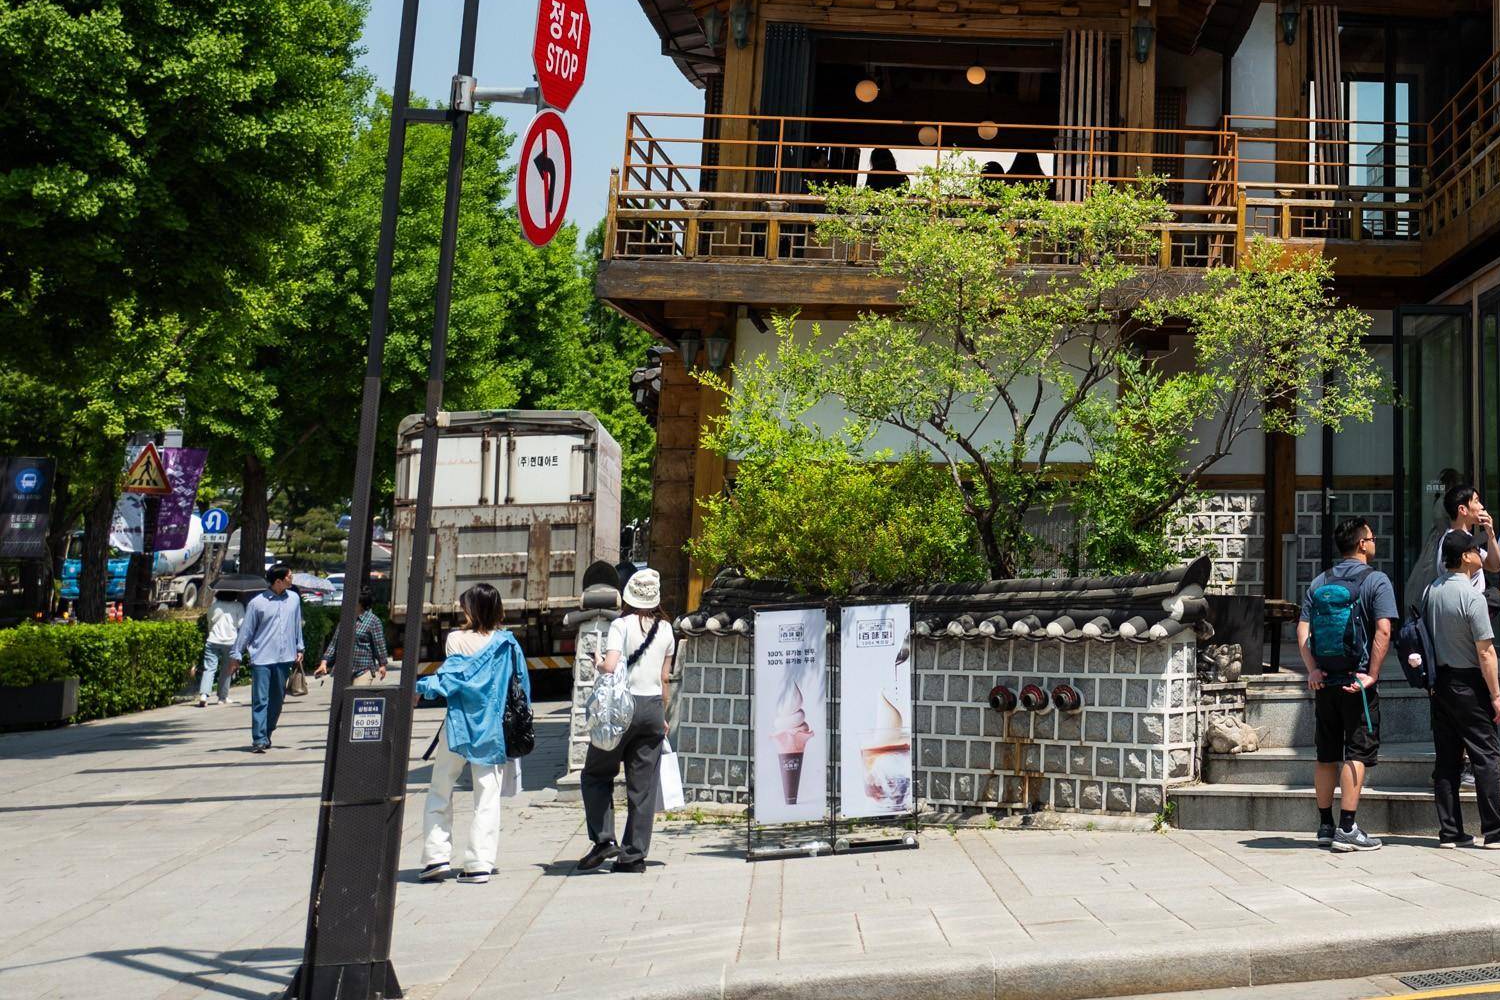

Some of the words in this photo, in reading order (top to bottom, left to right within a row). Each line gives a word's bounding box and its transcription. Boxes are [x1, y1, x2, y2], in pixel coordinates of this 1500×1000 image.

[549, 0, 584, 50] 정지
[545, 42, 579, 82] STOP
[517, 455, 559, 468] (주)현대아트
